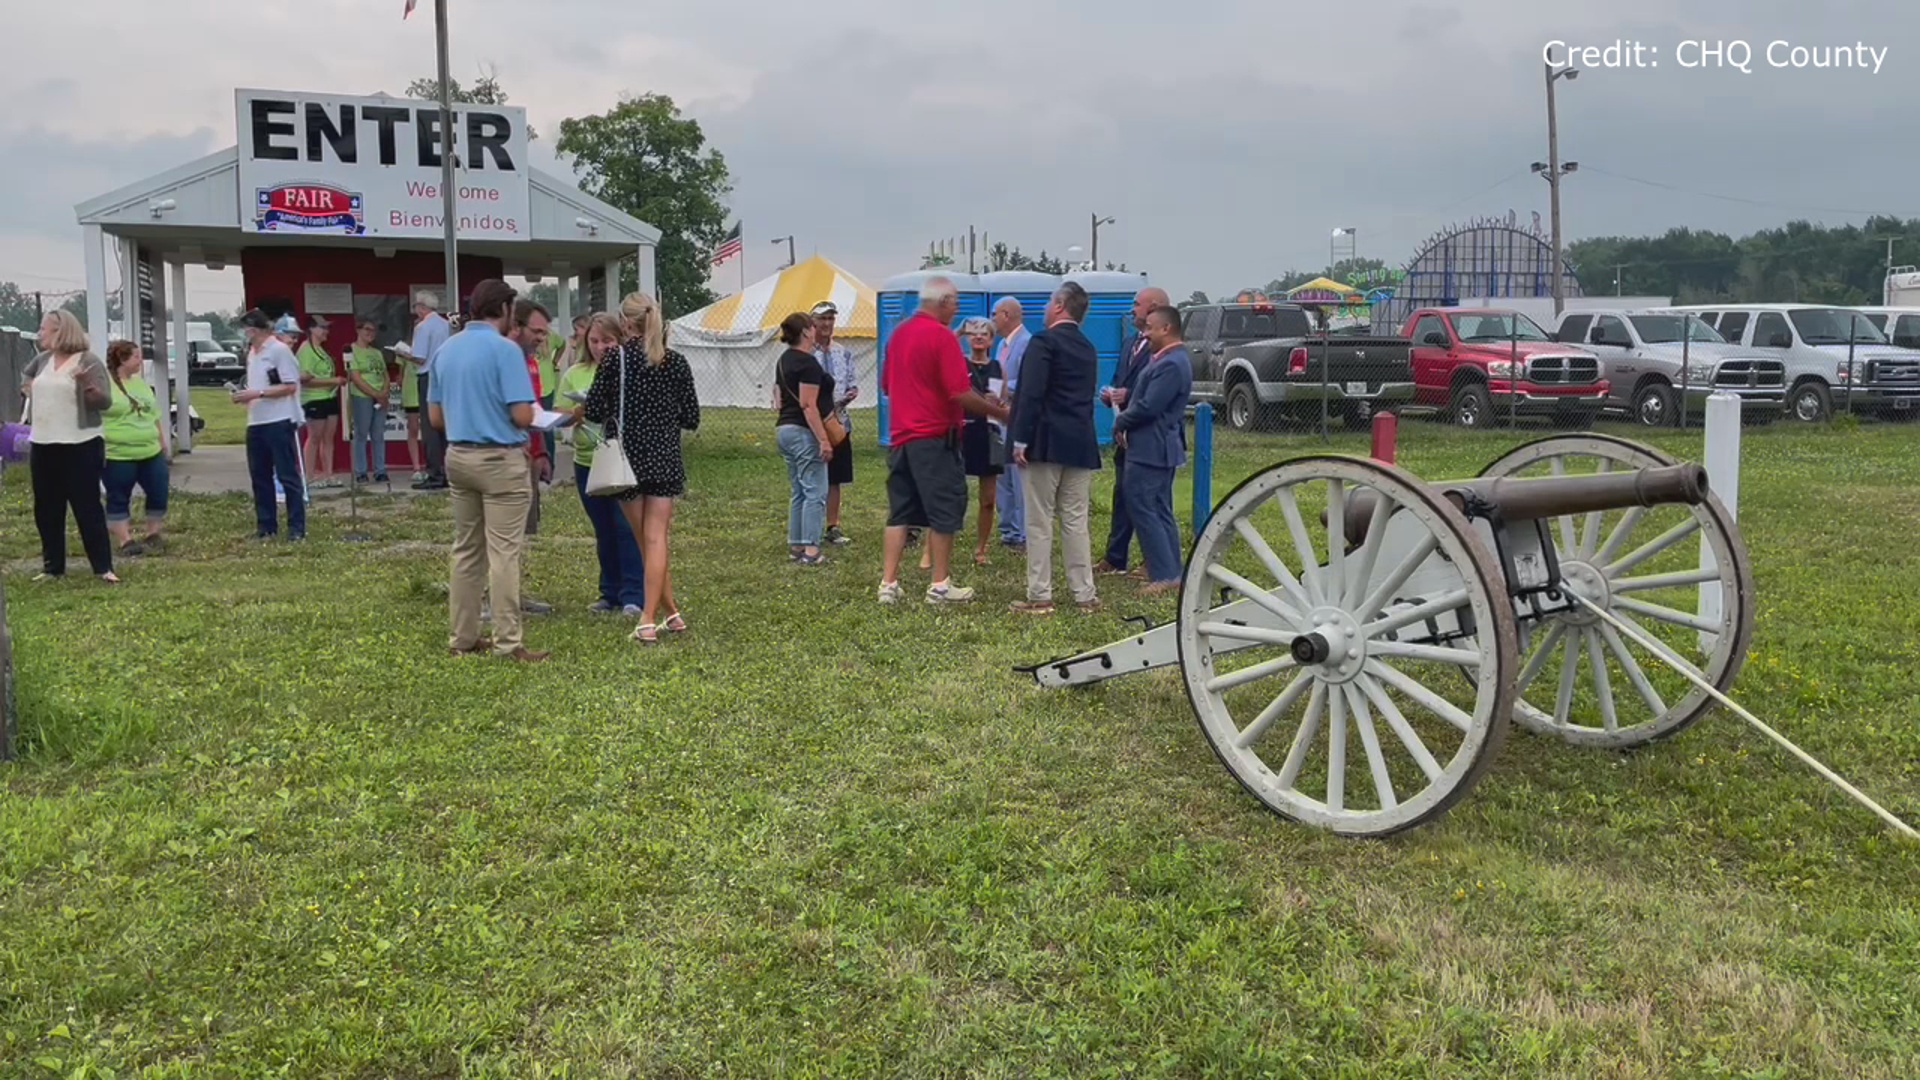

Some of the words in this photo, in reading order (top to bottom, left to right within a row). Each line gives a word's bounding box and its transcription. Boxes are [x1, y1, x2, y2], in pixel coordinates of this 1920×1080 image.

[251, 99, 516, 171] ENTER
[283, 188, 334, 209] FAIR
[406, 181, 499, 200] Welome
[390, 209, 516, 231] Bienvnidos
